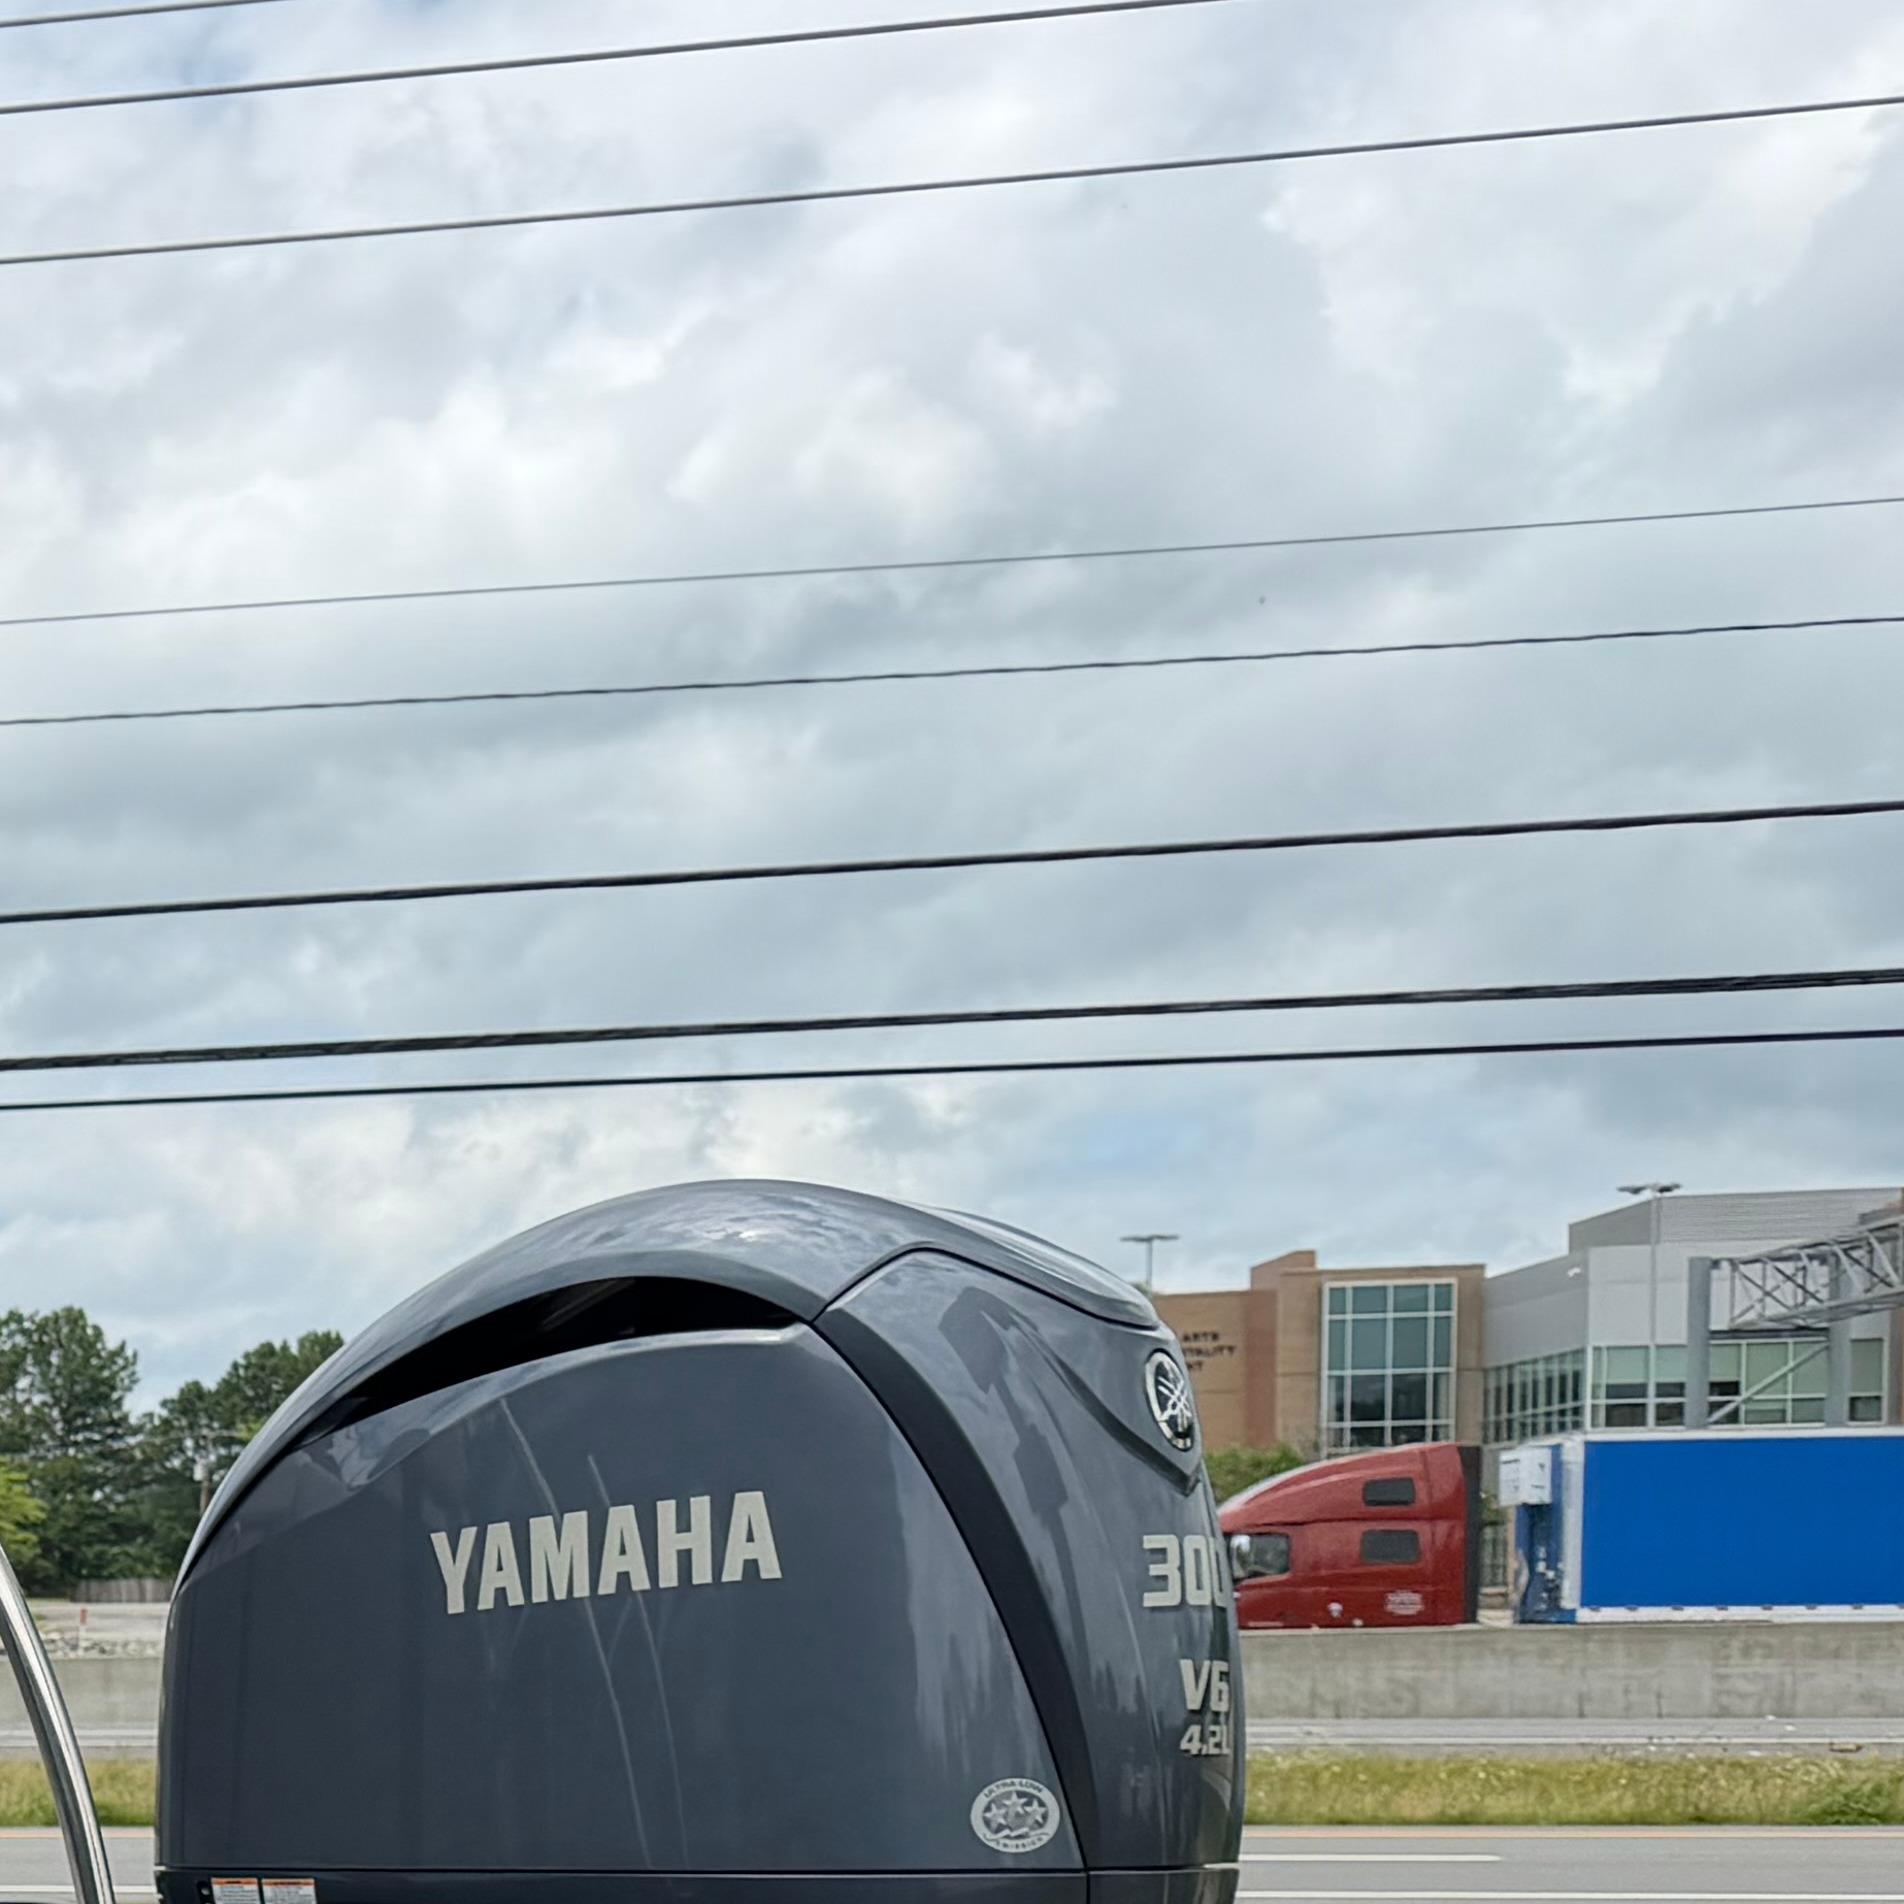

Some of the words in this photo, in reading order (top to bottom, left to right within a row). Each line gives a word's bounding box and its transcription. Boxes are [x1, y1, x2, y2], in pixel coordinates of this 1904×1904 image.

[429, 1490, 783, 1615] YAMAHA
[1142, 1534, 1228, 1608] 300
[1179, 1658, 1230, 1713] V6
